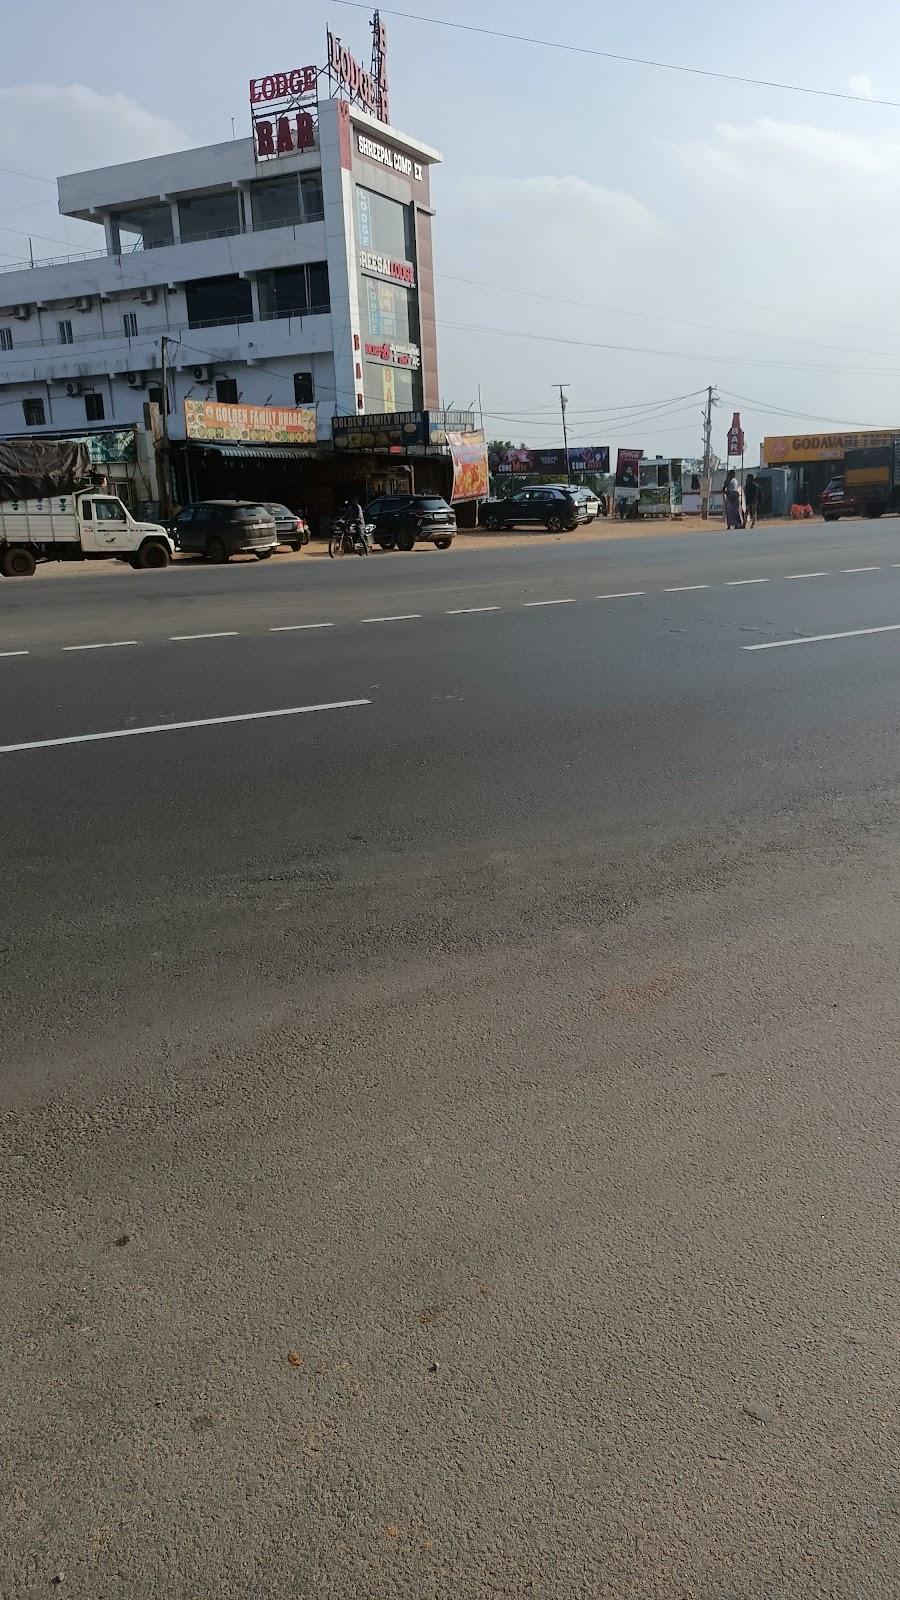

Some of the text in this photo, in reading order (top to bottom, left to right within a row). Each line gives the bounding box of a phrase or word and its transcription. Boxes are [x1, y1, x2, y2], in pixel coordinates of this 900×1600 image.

[250, 66, 316, 103] LODGE
[255, 112, 315, 157] BAR
[358, 135, 423, 182] SHREEPAL COMPEX
[359, 189, 370, 247] LODGE
[216, 406, 303, 428] GOLDEN FAMILY DHABA
[333, 416, 363, 429] GOLDEN
[364, 414, 392, 427] FAMILY
[394, 411, 421, 424] DHABA
[731, 427, 739, 451] BAR
[792, 433, 858, 450] GODAVA
